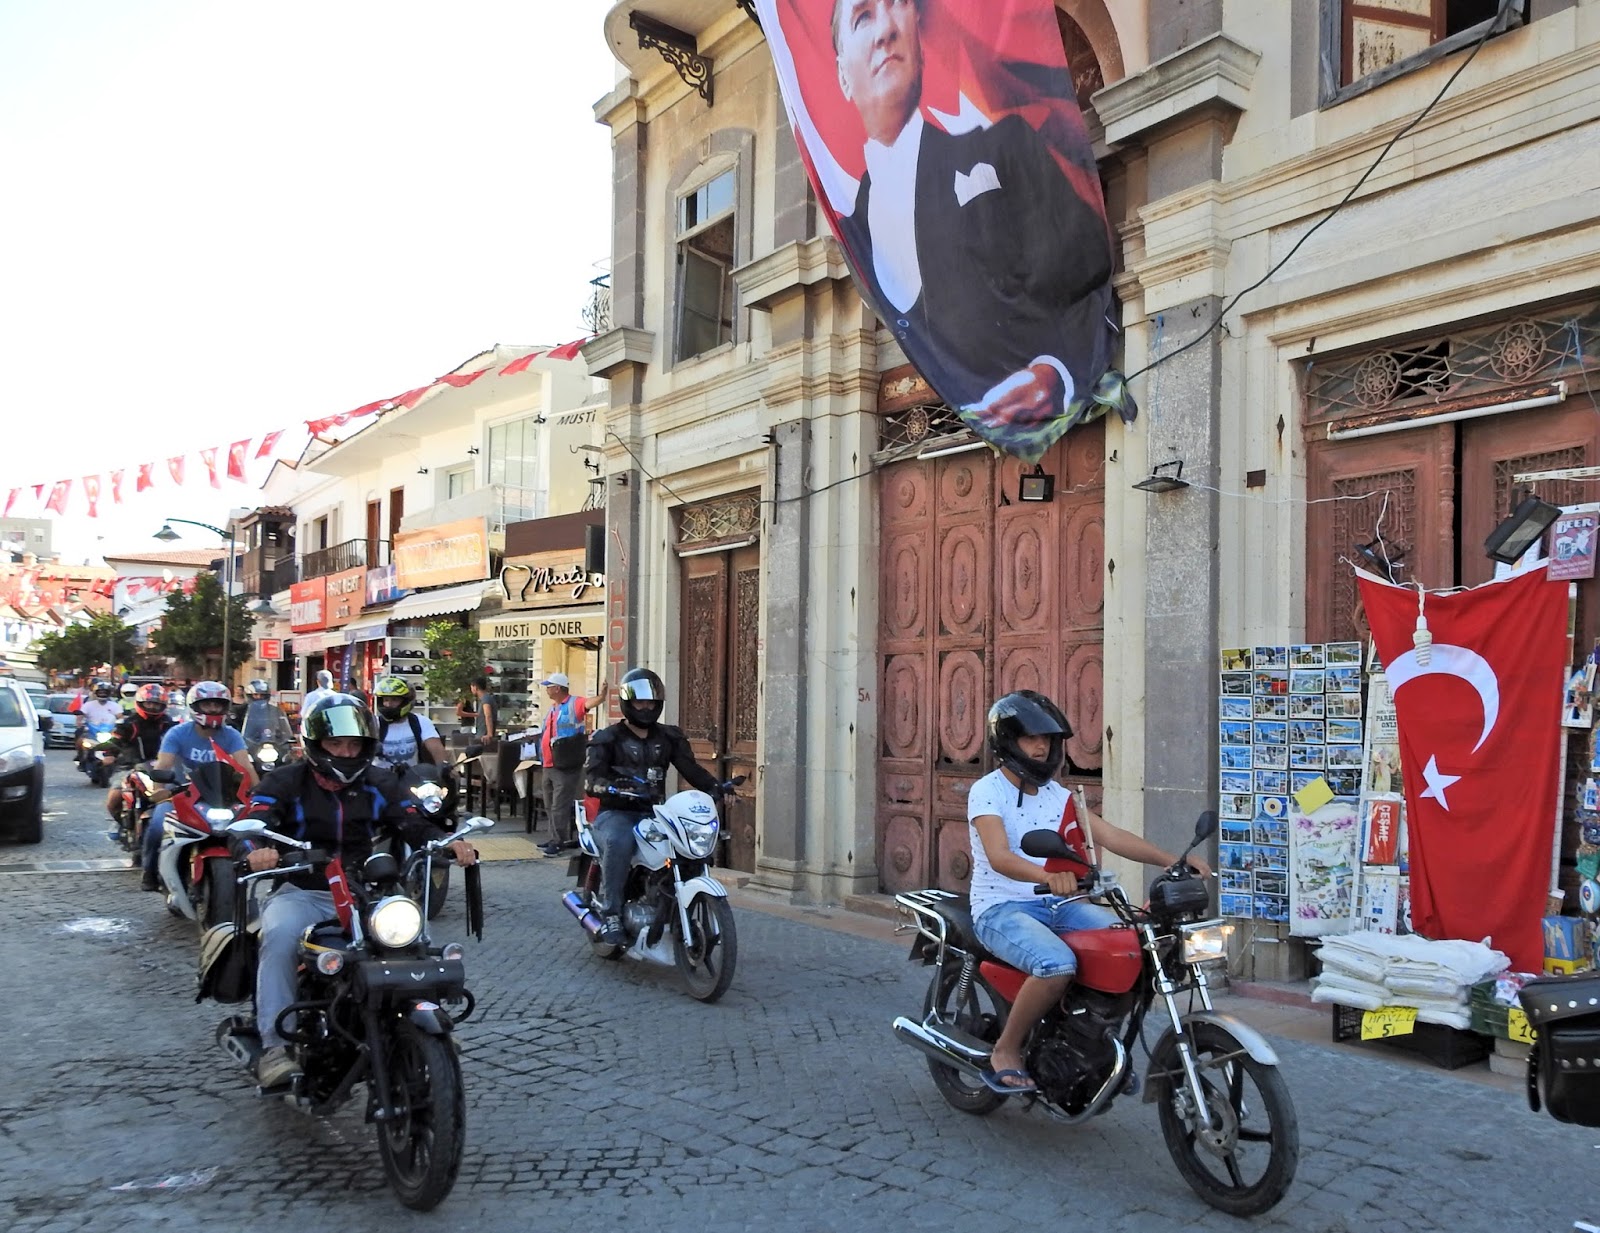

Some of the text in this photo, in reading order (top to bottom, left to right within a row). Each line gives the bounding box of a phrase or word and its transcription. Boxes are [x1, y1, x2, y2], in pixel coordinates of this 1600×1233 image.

[1556, 518, 1593, 534] BEER
[531, 565, 593, 600] Musty
[540, 619, 582, 636] DÖNER
[262, 641, 279, 659] E
